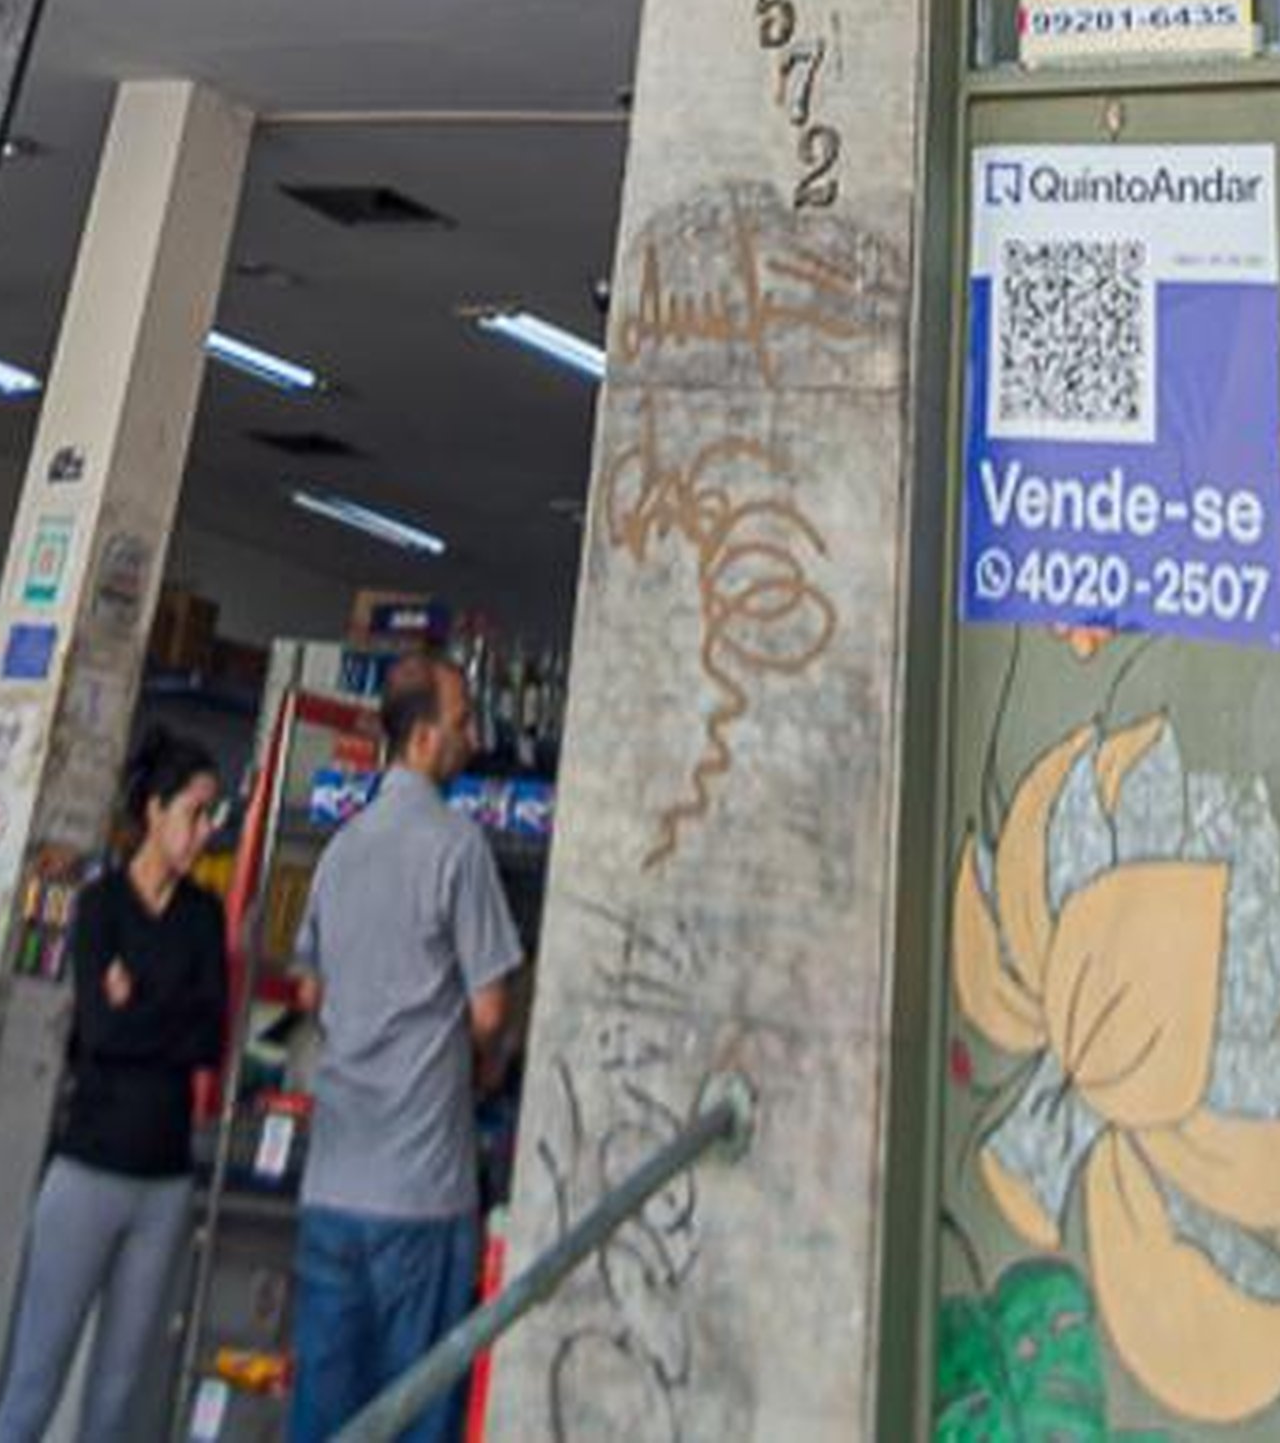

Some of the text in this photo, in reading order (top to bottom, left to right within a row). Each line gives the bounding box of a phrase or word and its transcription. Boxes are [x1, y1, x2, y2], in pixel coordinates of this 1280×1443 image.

[1028, 165, 1263, 206] QuintoAndar
[980, 459, 1264, 544] Vende-se
[1016, 549, 1270, 622] 4020-2507
